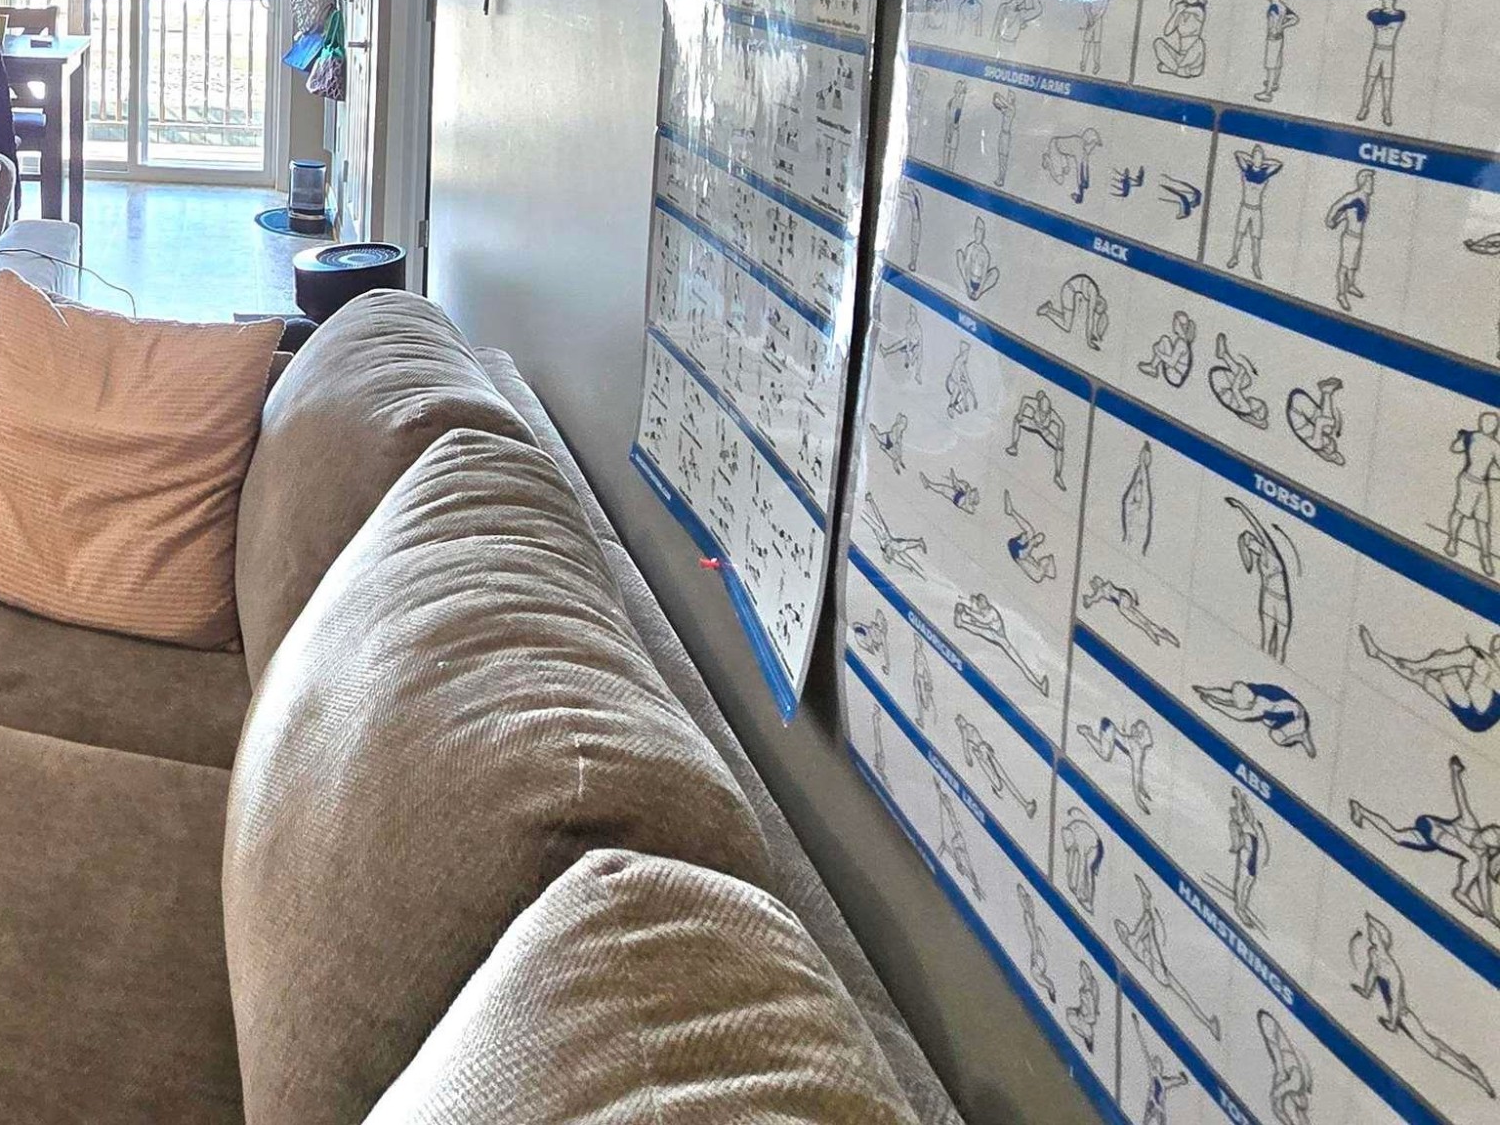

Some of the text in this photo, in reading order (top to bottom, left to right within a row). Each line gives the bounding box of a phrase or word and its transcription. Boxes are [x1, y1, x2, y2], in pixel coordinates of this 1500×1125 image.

[984, 65, 1072, 96] SHOULDERS/ARMS
[1358, 142, 1428, 171] CHEST
[1093, 236, 1130, 262] BACK
[1253, 473, 1317, 518] TORSO
[1235, 763, 1271, 799] ABS
[1178, 880, 1295, 1006] HAMSTRINGS
